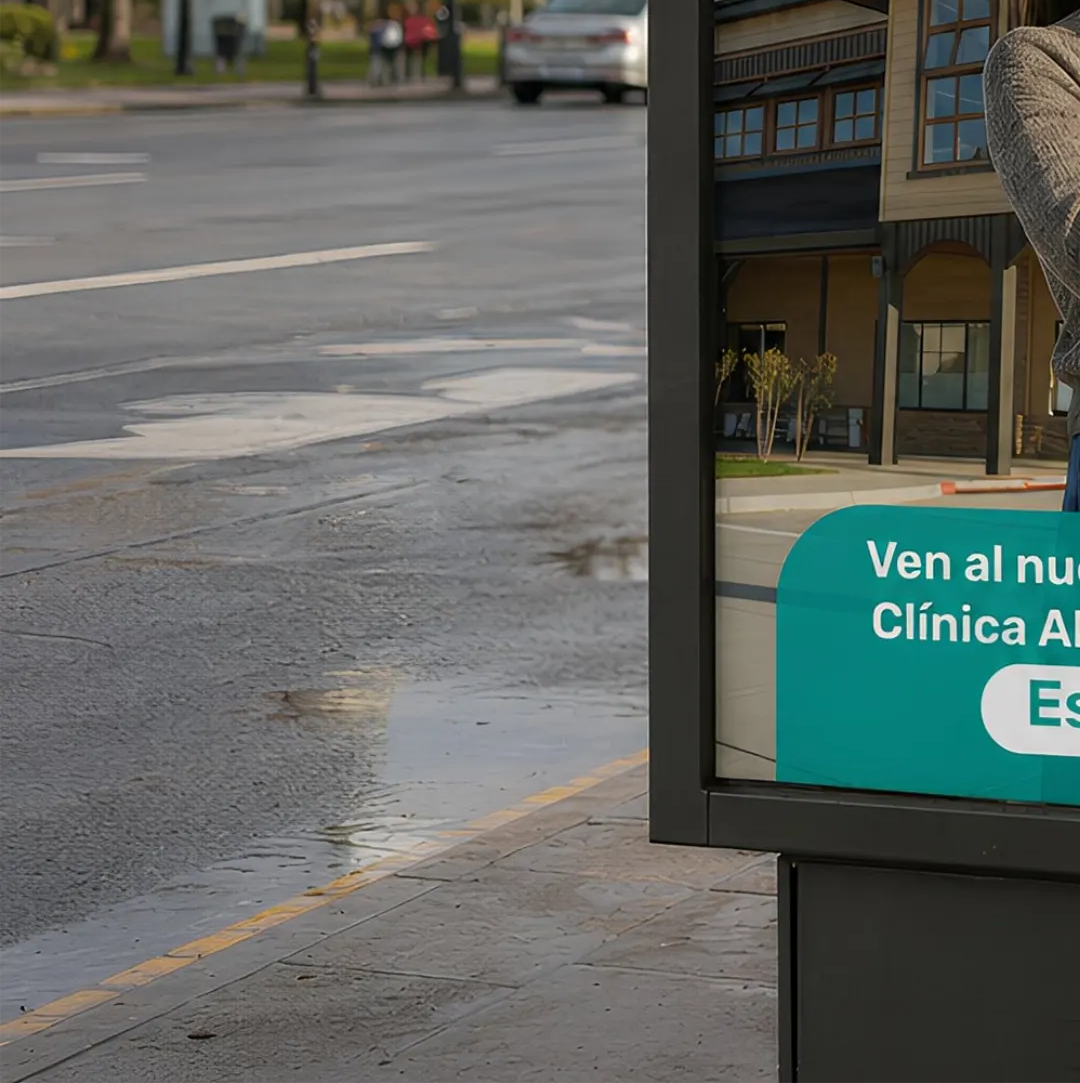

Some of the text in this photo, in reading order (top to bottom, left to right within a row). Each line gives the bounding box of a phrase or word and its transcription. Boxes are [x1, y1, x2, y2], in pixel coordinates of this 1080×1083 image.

[866, 540, 951, 580] Ven
[964, 544, 1002, 583] al
[872, 601, 1026, 646] Clínica
